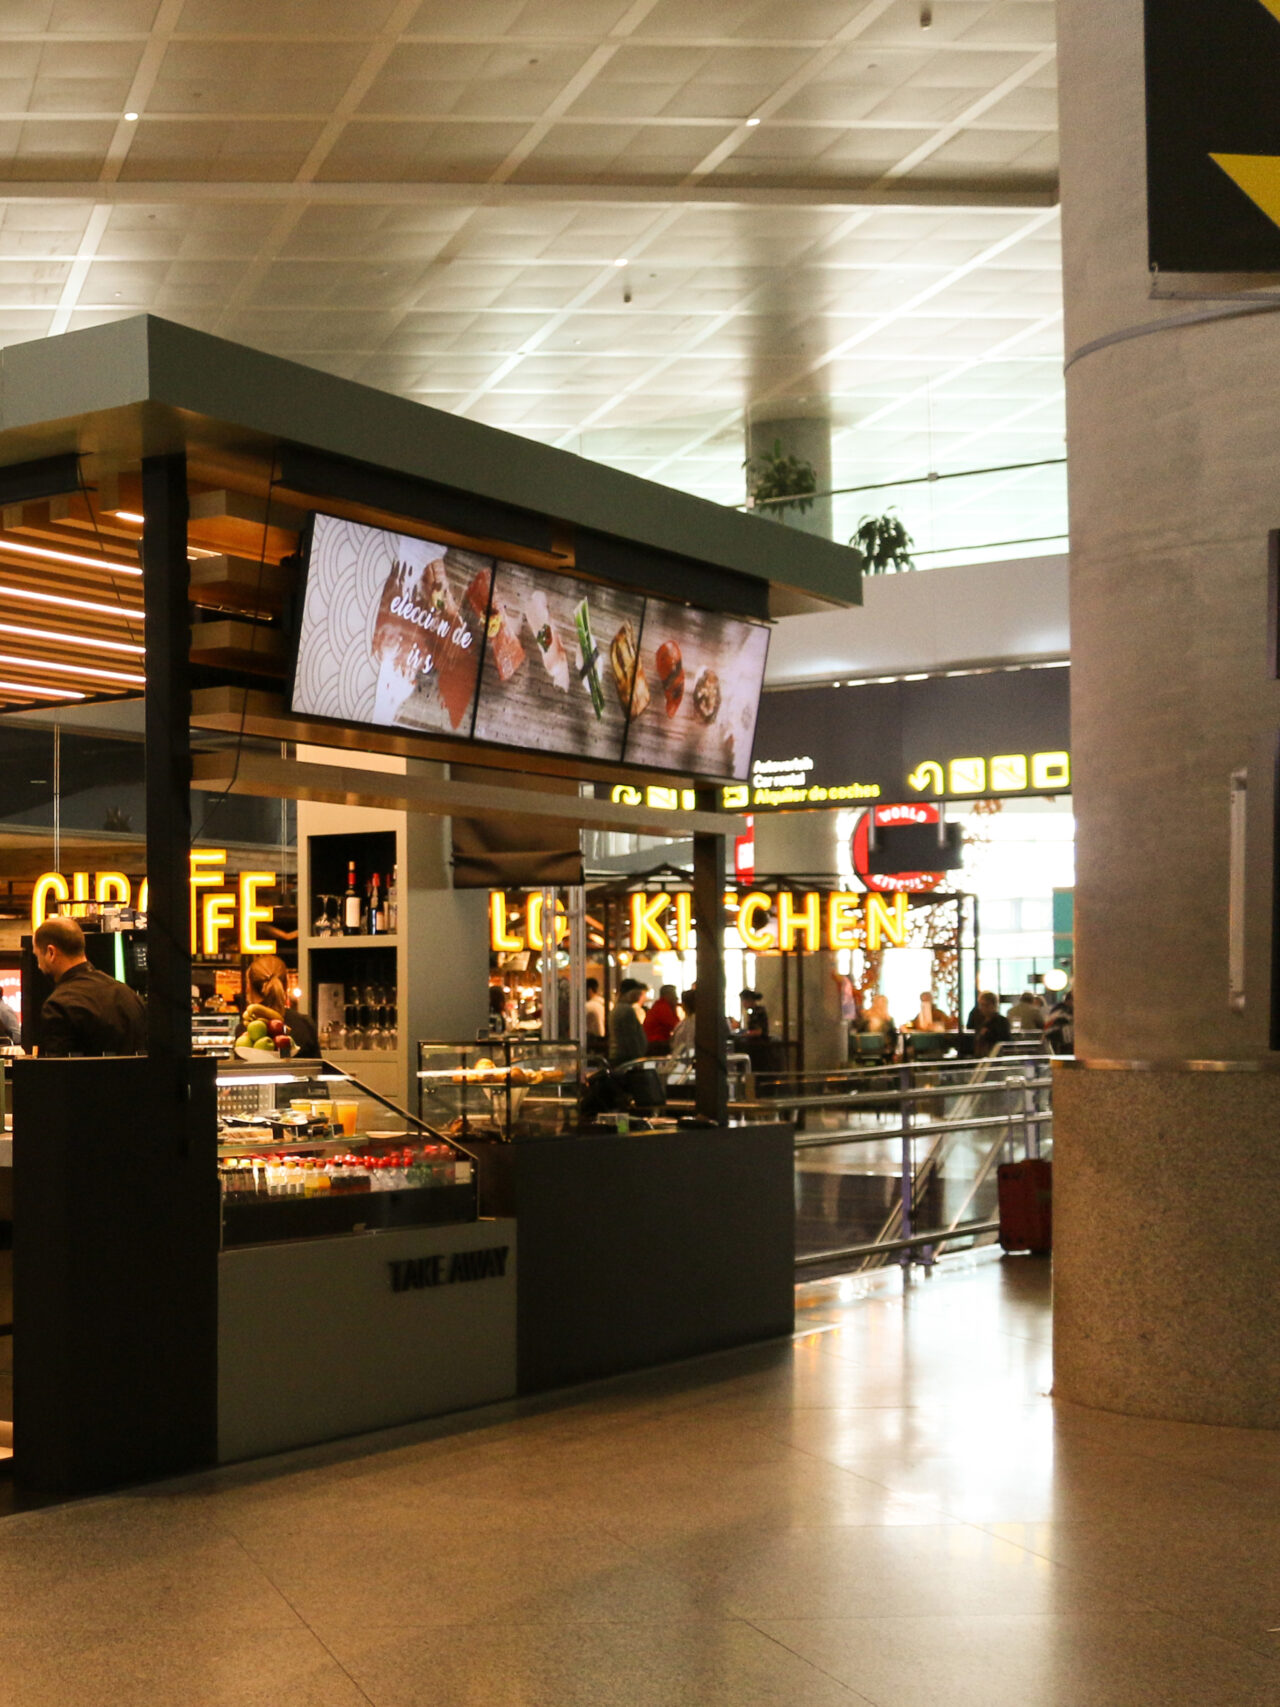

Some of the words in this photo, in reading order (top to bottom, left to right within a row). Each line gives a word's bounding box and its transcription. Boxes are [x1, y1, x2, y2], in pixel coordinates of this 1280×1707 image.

[452, 621, 472, 648] de
[753, 774, 773, 788] Car
[754, 787, 808, 806] Alquiler
[808, 785, 828, 801] de
[828, 782, 880, 800] coches
[878, 806, 927, 823] WORLD
[631, 891, 908, 952] KICHEN
[388, 1254, 446, 1293] TAKE
[448, 1245, 509, 1284] AWAY
